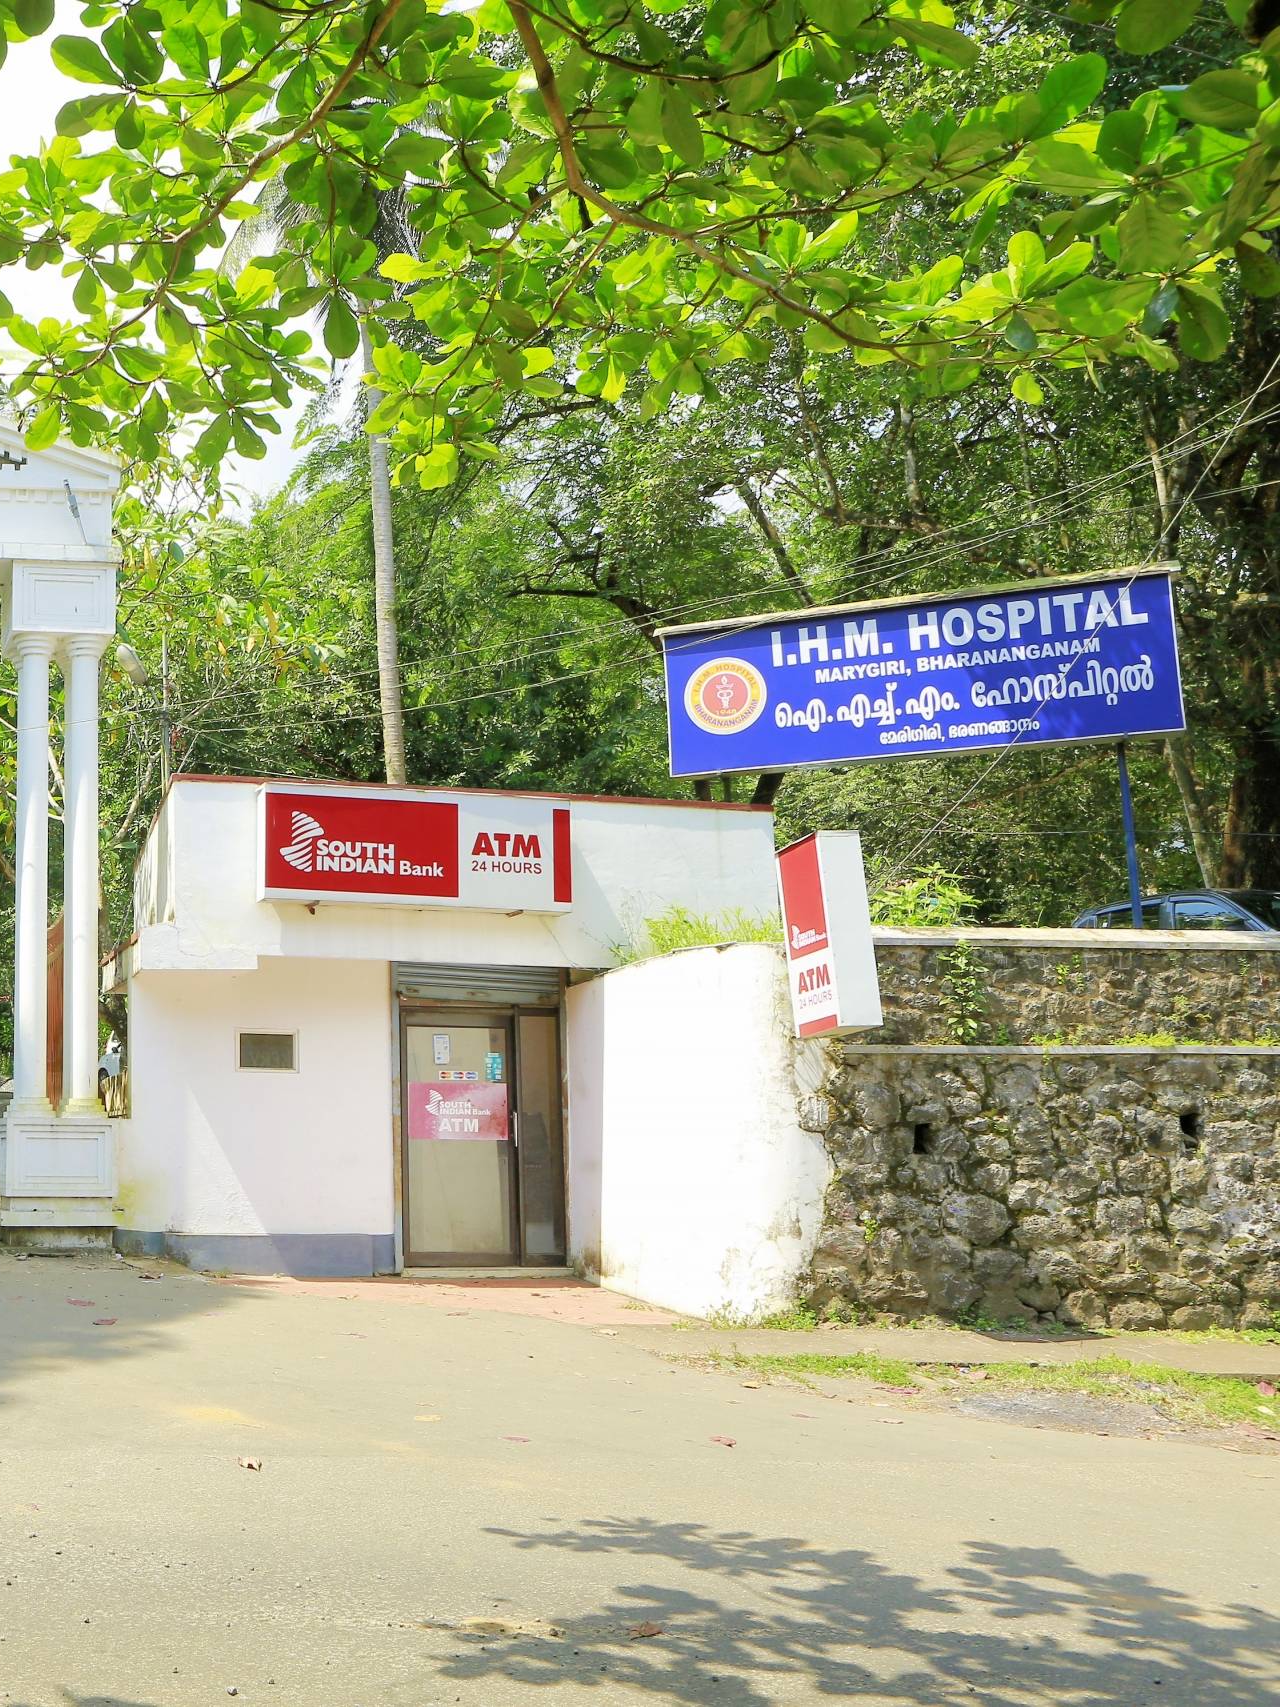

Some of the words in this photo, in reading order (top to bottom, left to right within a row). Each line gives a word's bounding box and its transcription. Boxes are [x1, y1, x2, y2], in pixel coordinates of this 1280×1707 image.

[771, 618, 895, 667] I.H.M.
[908, 586, 1149, 651] HOSPITAL
[815, 658, 912, 684] MARYGIRI,
[917, 637, 1101, 672] BHARANANGANAM
[316, 839, 395, 860] SOUTH
[471, 832, 541, 858] ATM
[316, 856, 395, 875] INDIAN
[399, 860, 444, 877] Bank
[471, 860, 486, 872] 24
[491, 861, 542, 874] HOURS
[798, 963, 831, 994] ATM
[808, 989, 833, 1006] HOURS
[439, 1101, 472, 1109] SOUTH
[472, 1108, 492, 1116] Bank
[438, 1118, 479, 1133] ATM
